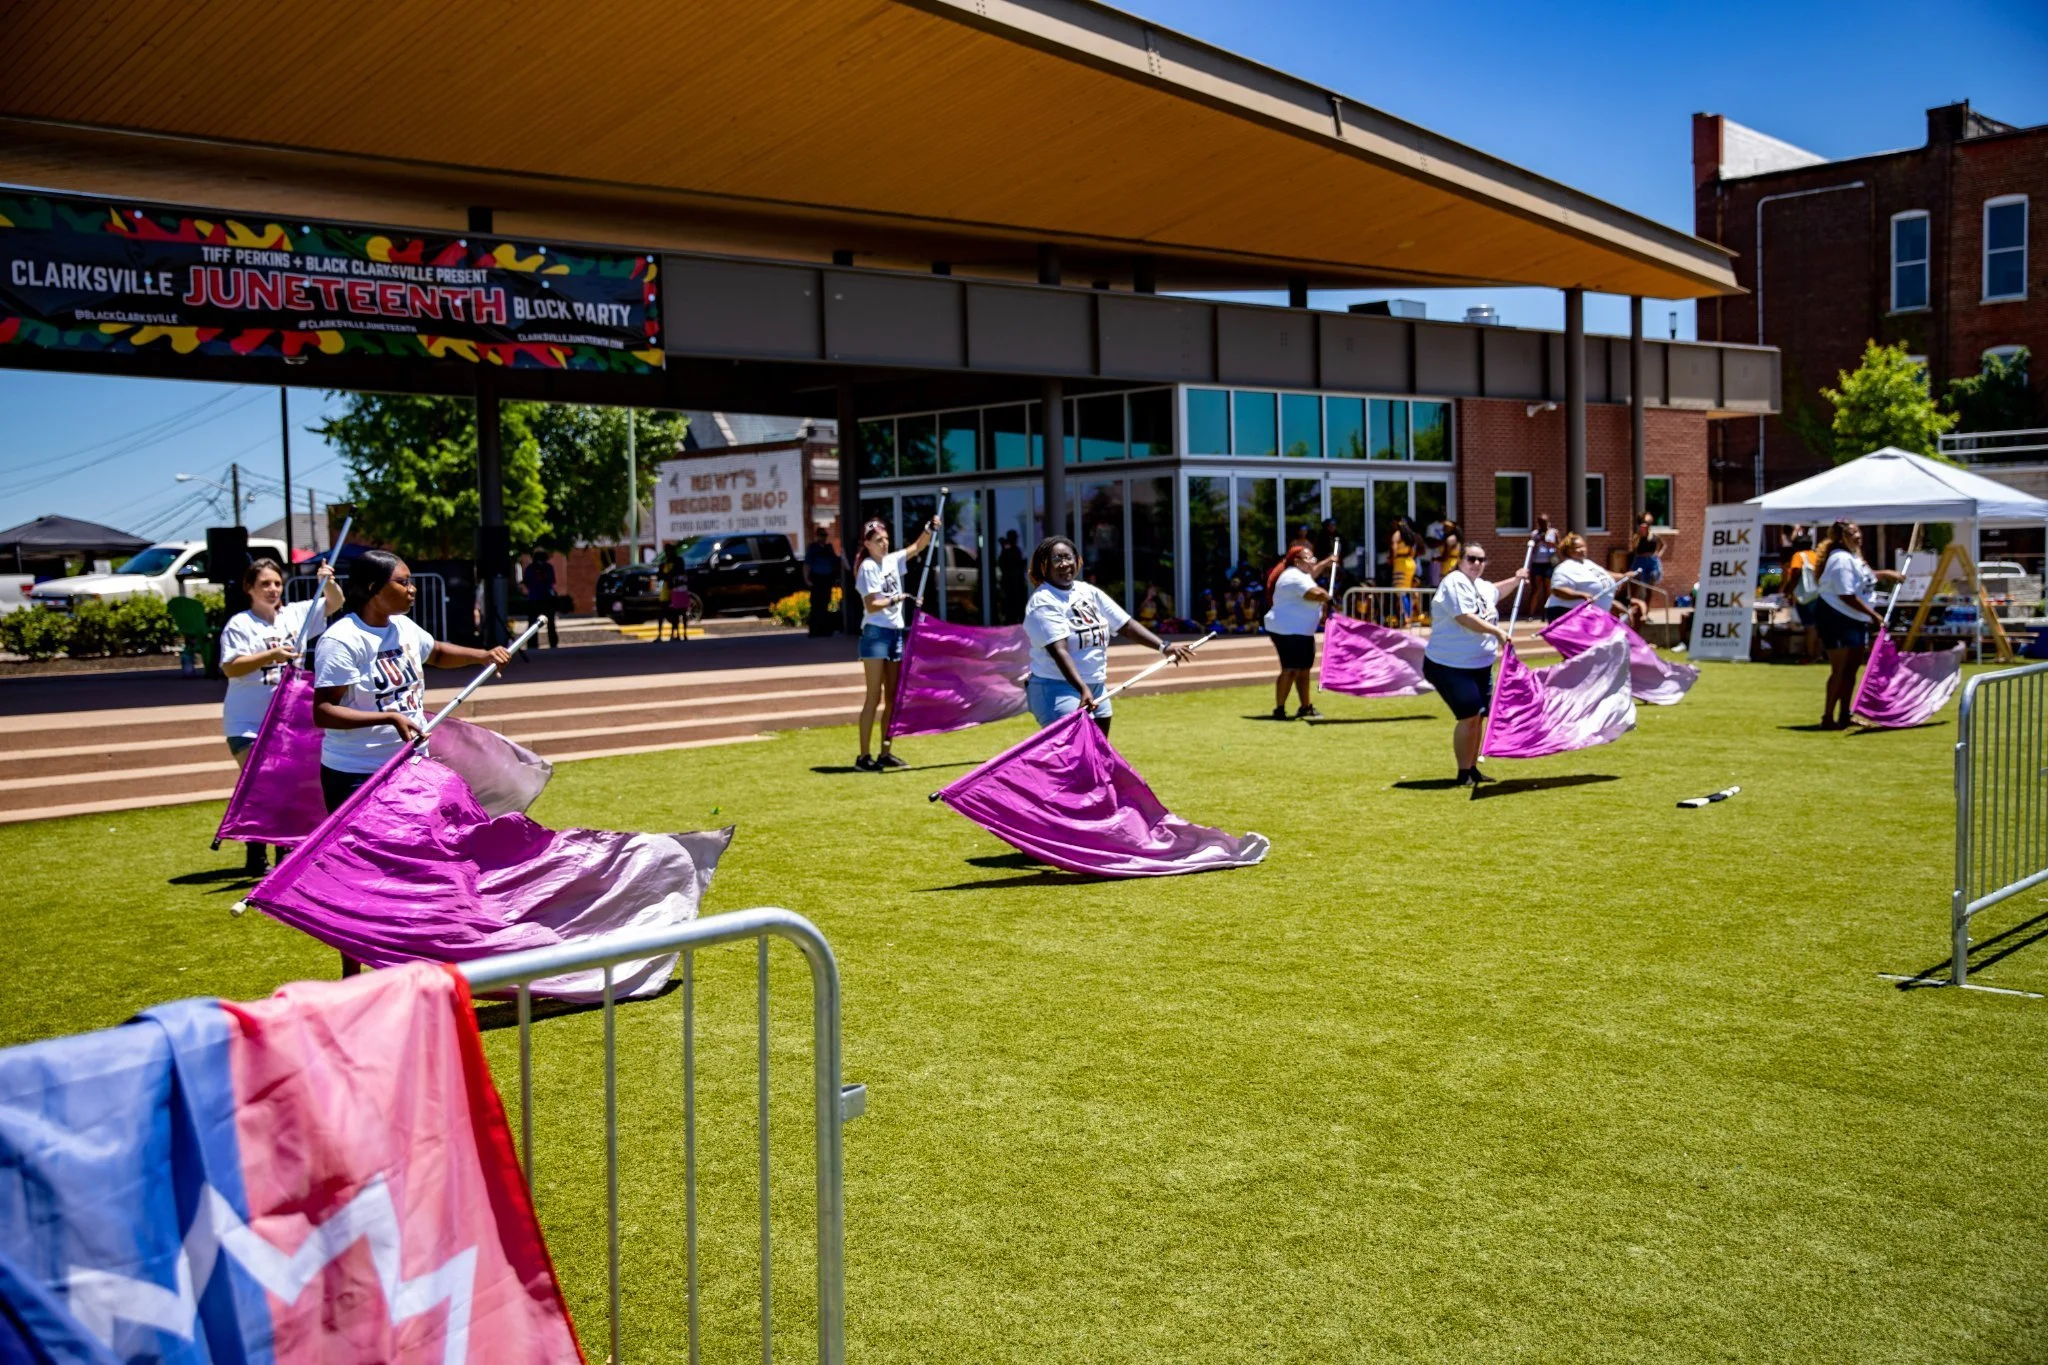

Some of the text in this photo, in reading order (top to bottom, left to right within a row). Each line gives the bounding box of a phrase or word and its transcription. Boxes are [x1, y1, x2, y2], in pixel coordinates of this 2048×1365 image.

[202, 246, 231, 263] TIFF
[235, 249, 291, 268] PERKINS
[306, 256, 348, 274] BLACK
[352, 259, 433, 282] CLARKSVILLE
[436, 268, 488, 284] PRESENT
[11, 260, 174, 296] CLARKSVILLE
[183, 265, 507, 325] JUNETEENTH
[513, 296, 631, 327] BLOCK PARTY
[670, 491, 788, 514] RECORD SHOP
[1712, 528, 1751, 546] BLK
[1709, 560, 1748, 577] BLK
[1705, 592, 1744, 608] BLK
[1702, 622, 1741, 639] BLK
